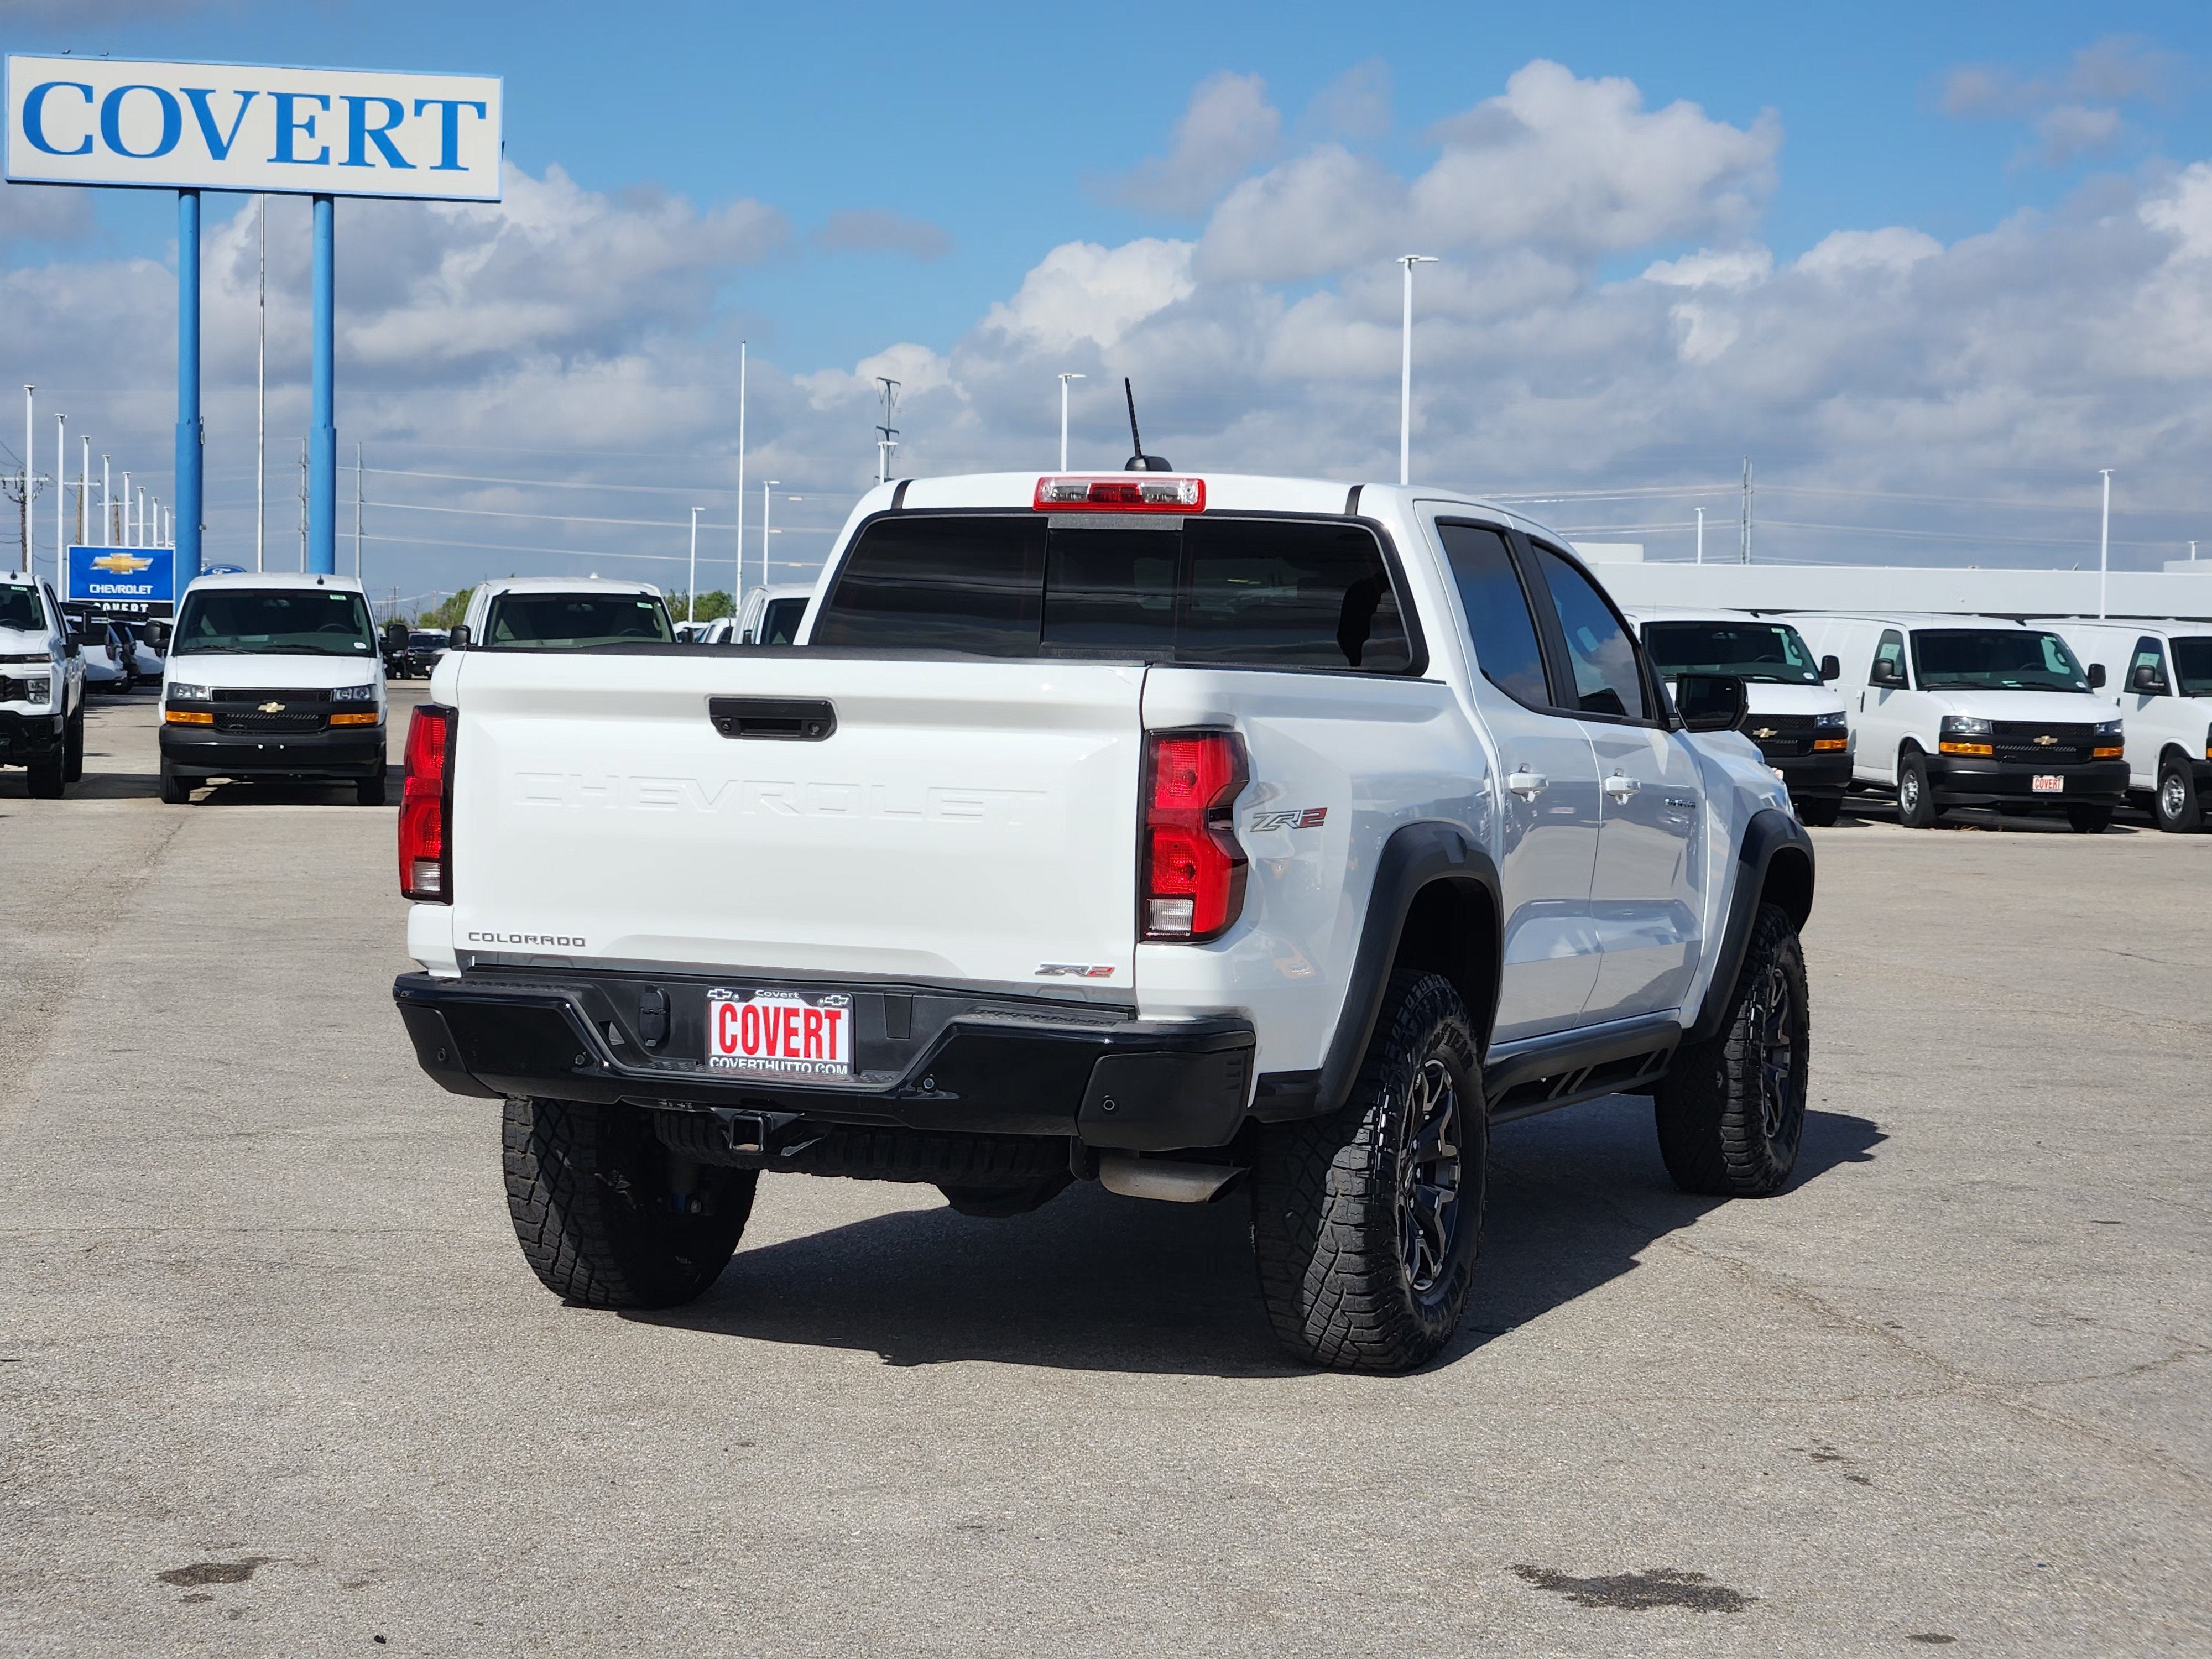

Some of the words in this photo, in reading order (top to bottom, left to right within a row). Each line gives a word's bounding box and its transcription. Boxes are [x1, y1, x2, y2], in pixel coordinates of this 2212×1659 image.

[23, 81, 487, 171] COVERT
[89, 584, 153, 594] CHEVROLET
[2035, 778, 2061, 789] COVERT
[514, 772, 1048, 825] CHEVROLET
[1250, 807, 1328, 833] ZR2
[468, 932, 586, 947] COLORADO
[1034, 963, 1115, 978] ZR2
[754, 989, 800, 999] Covert
[719, 1003, 842, 1061] COVERT
[709, 1056, 848, 1076] COVERTHUTTOCOM
